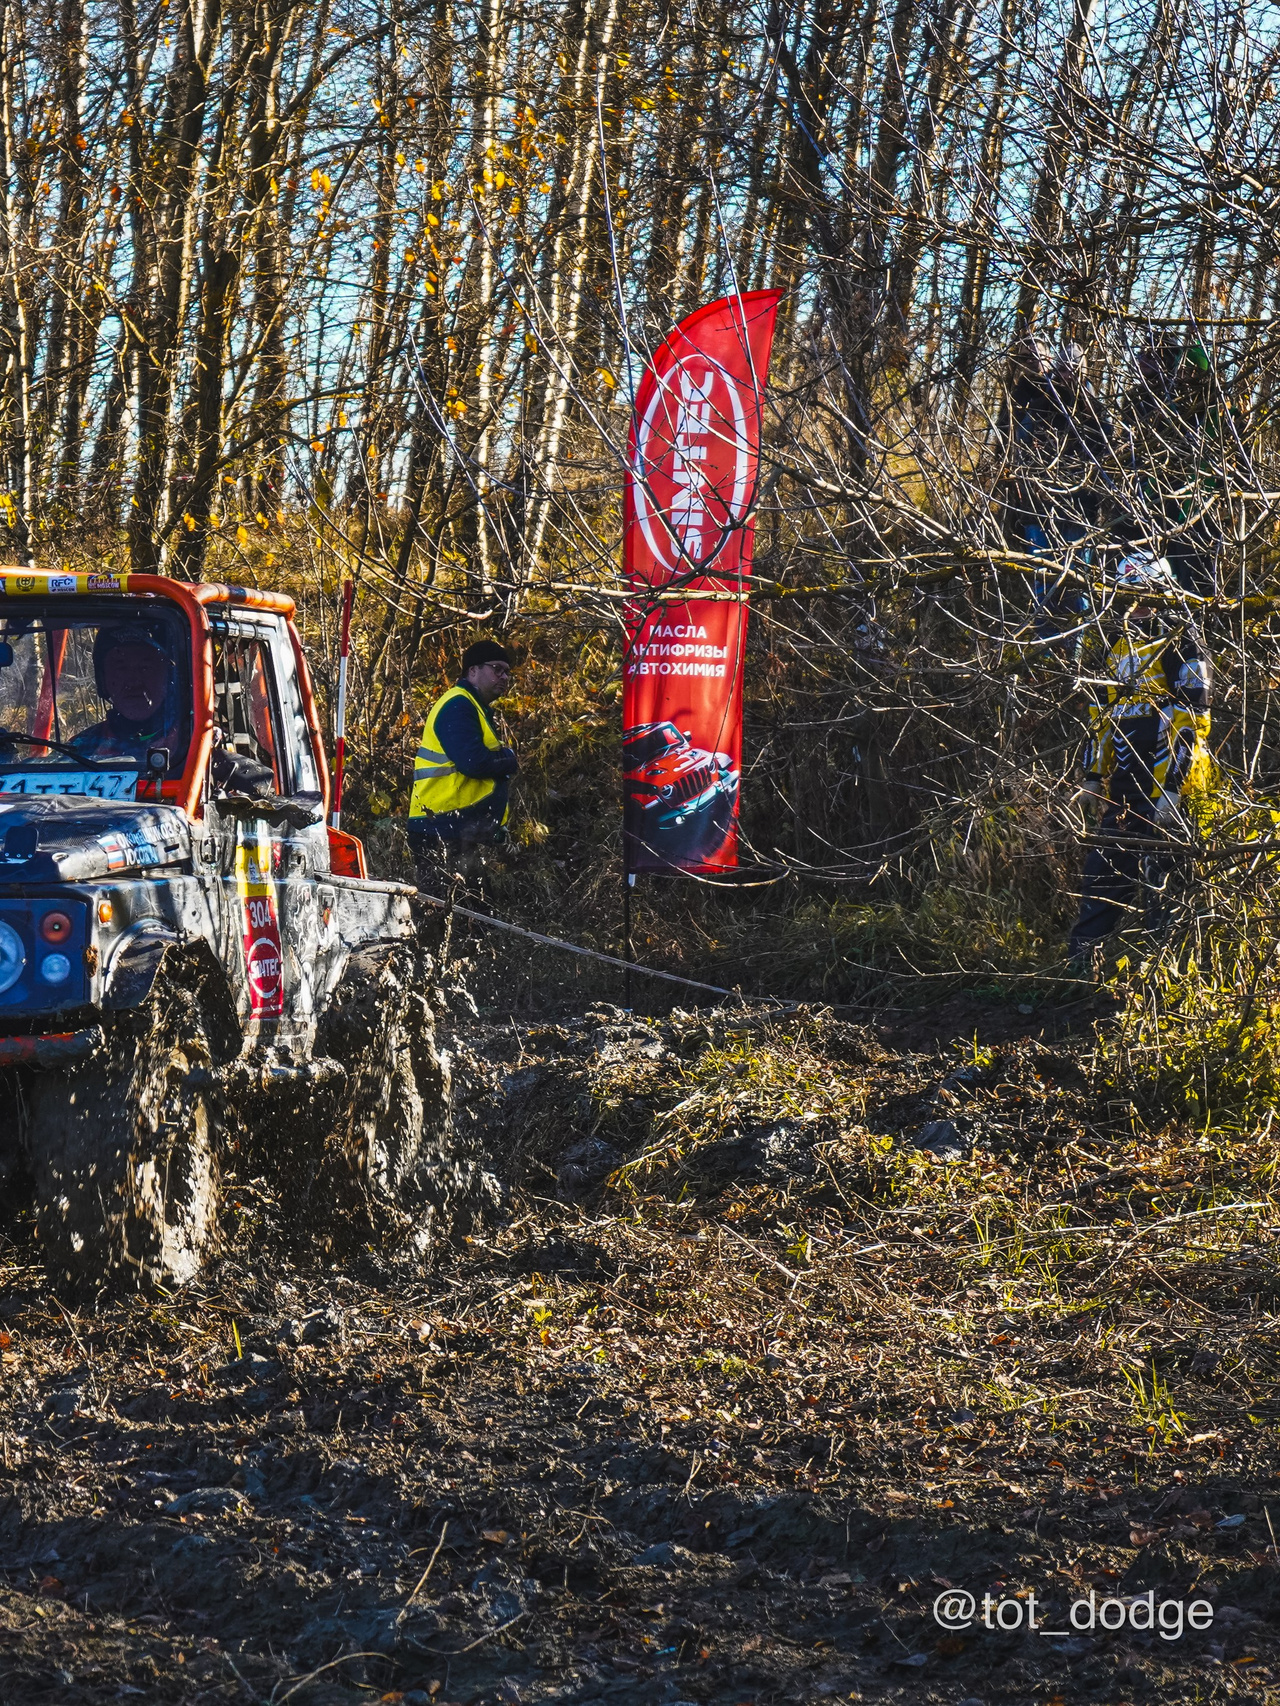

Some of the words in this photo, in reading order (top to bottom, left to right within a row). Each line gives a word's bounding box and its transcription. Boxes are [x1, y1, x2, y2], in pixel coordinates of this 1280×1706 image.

[670, 371, 713, 559] SINTEC
[649, 625, 707, 638] МАСЛА
[627, 662, 726, 677] АВТОХИМИЯ
[89, 775, 123, 797] 47
[249, 901, 271, 928] 304
